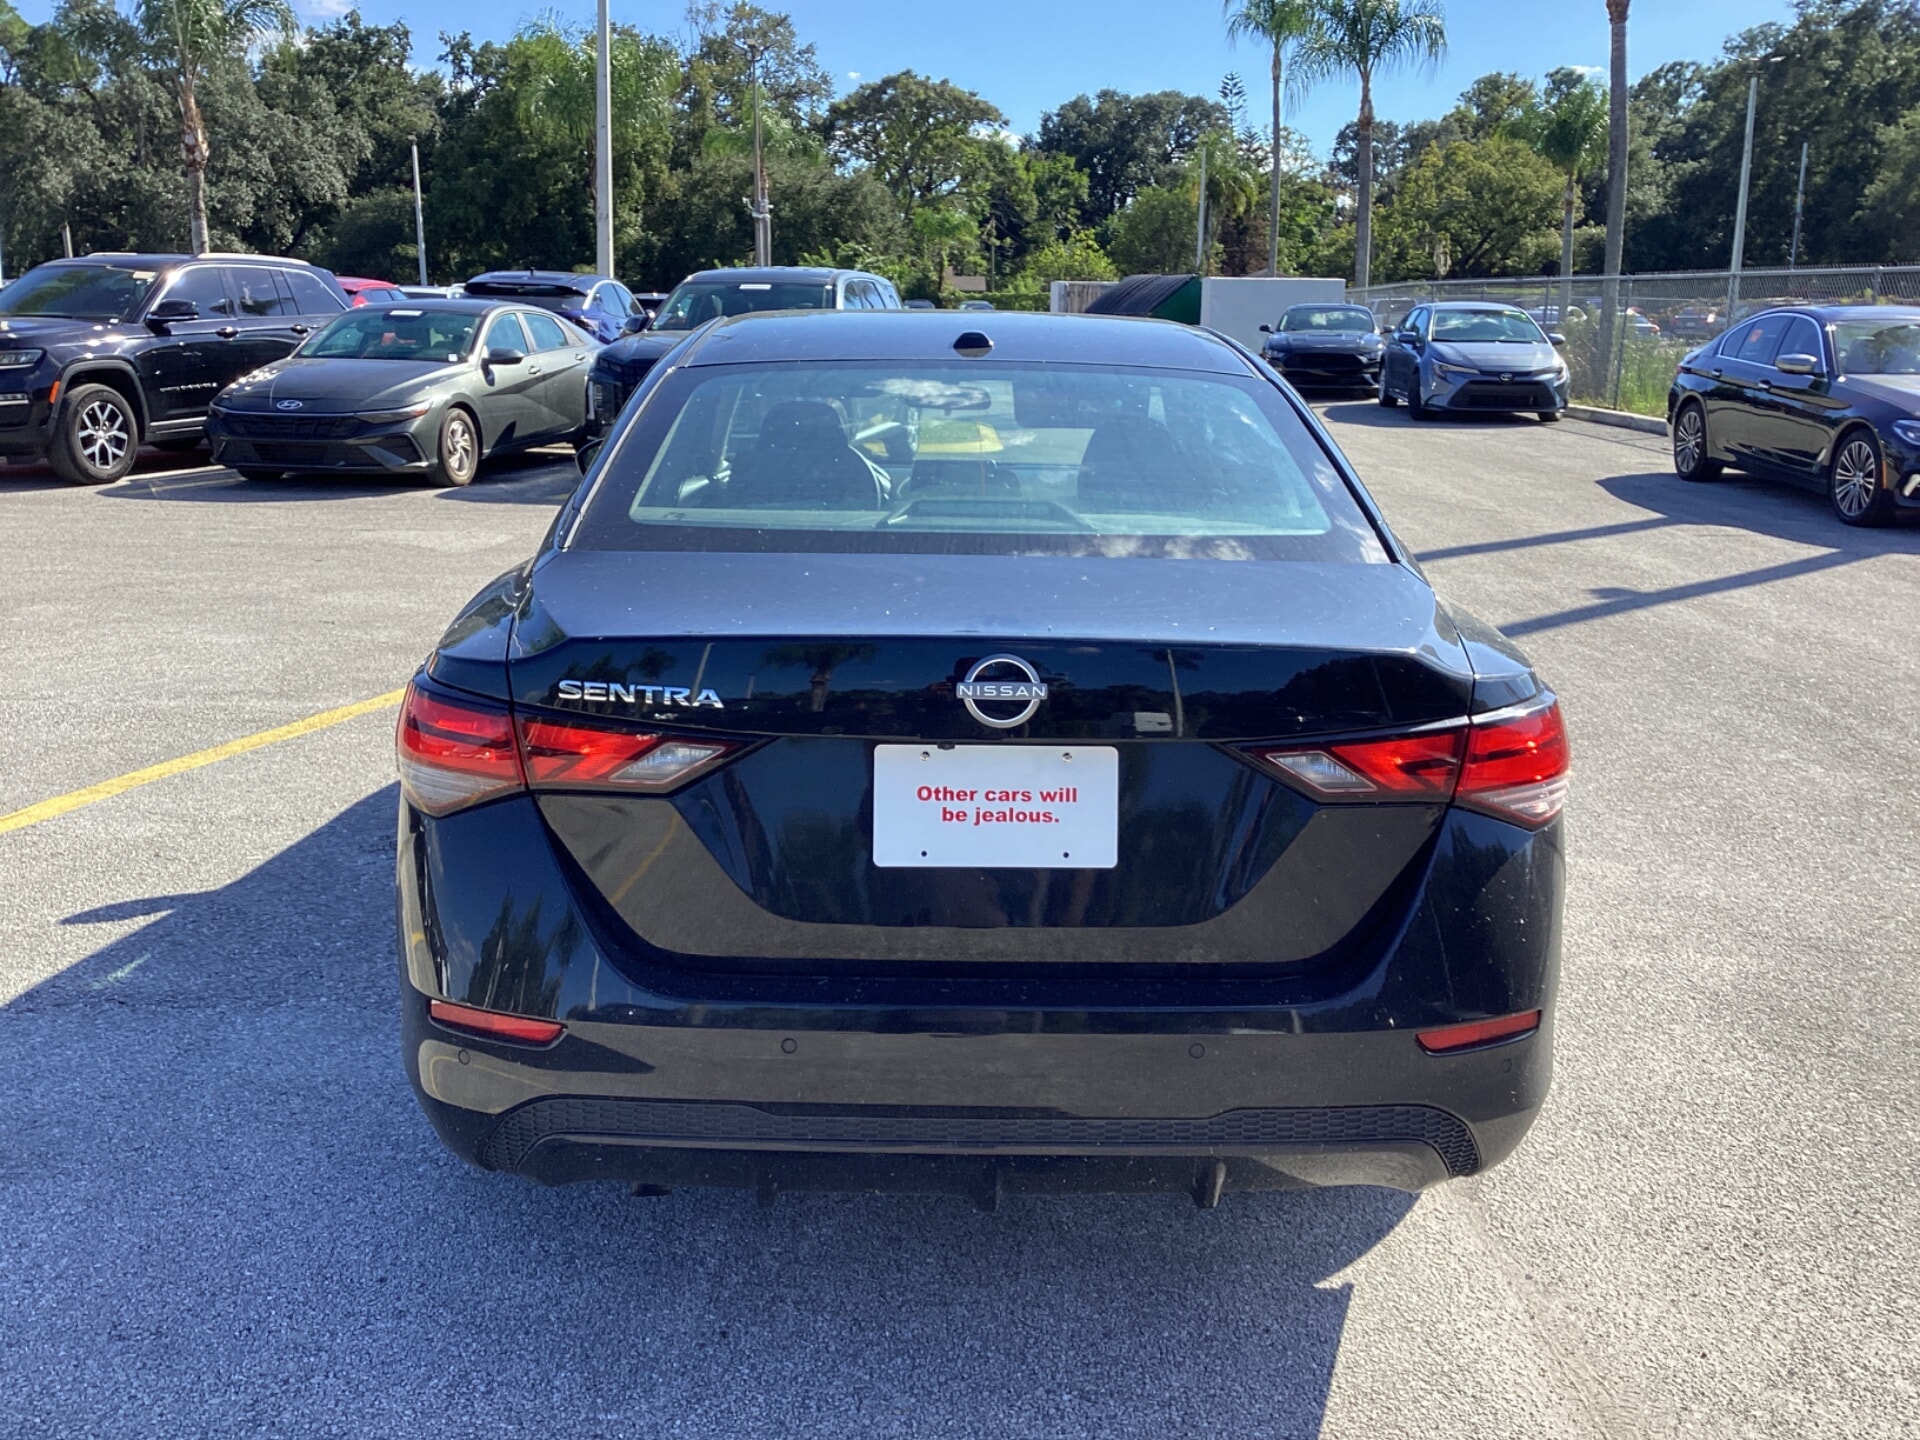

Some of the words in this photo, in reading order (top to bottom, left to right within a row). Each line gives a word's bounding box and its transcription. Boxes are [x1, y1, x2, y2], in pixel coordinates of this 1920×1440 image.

[558, 679, 724, 708] SENTRA
[959, 685, 1045, 697] NISSAN
[917, 785, 978, 802] Other
[984, 788, 1032, 802] cars
[1039, 787, 1078, 803] will
[941, 807, 968, 822] be
[973, 807, 1060, 826] jealous.
